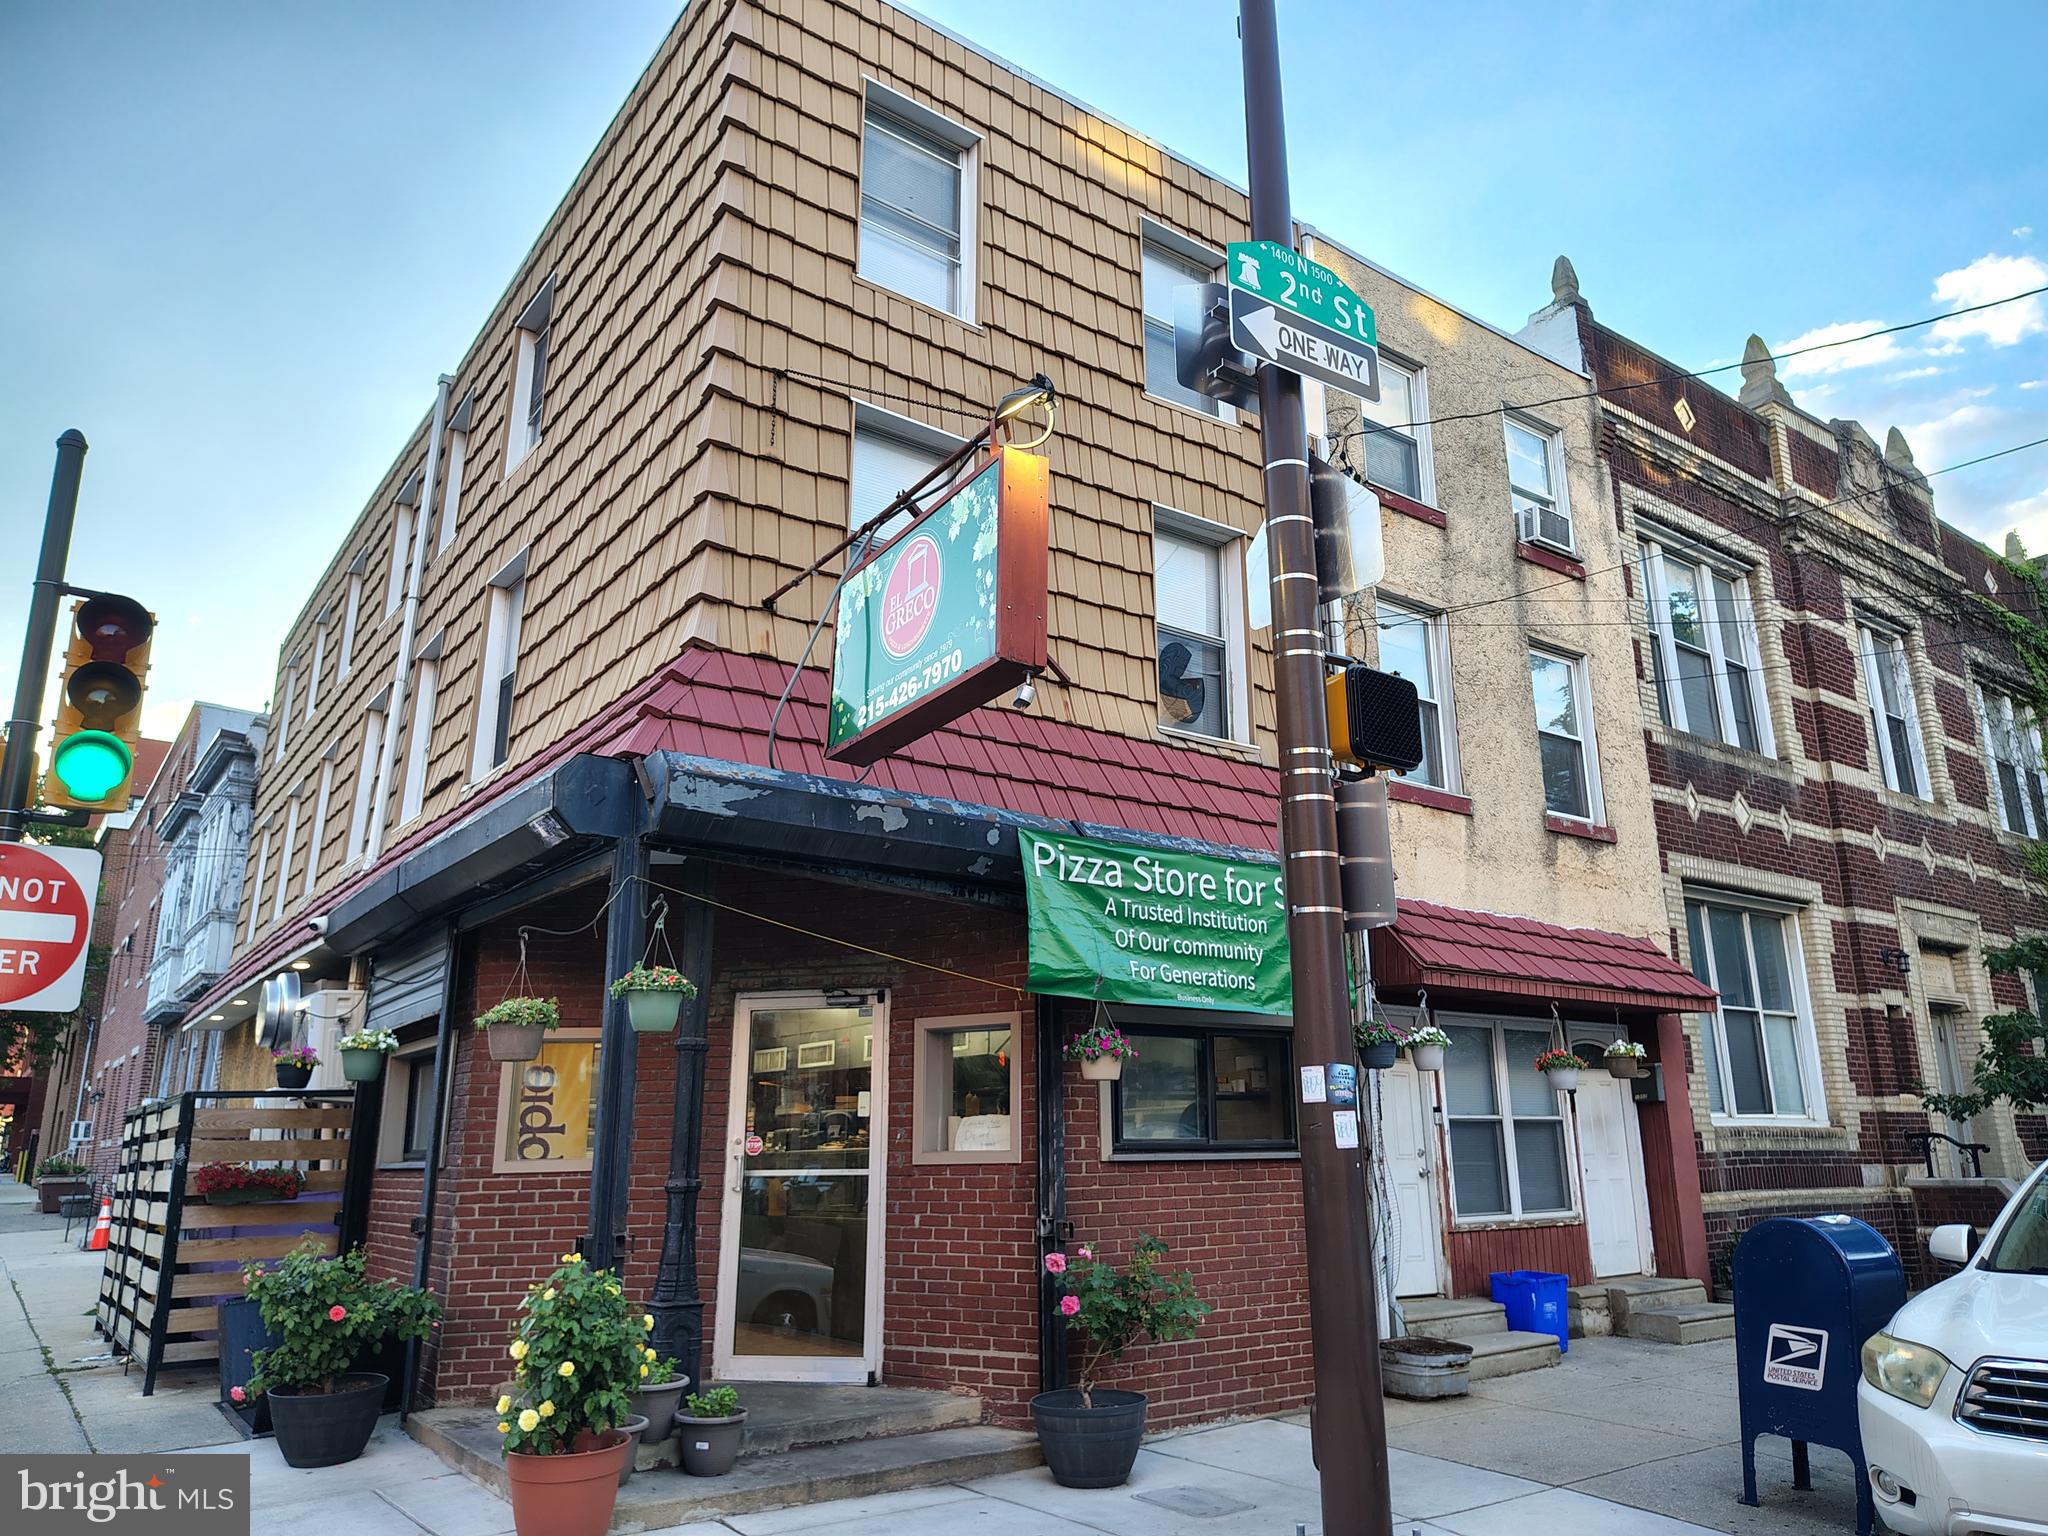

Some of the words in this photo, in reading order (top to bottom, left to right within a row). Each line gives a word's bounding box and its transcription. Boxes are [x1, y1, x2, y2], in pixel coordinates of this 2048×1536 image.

[1271, 246, 1295, 266] 1400
[1297, 258, 1308, 276] N
[1311, 266, 1333, 285] 1500
[1279, 271, 1322, 308] 2nd
[1333, 296, 1368, 338] St
[1278, 326, 1318, 362] ONE
[1326, 344, 1363, 379] WAY
[885, 586, 935, 635] GRECO
[890, 591, 903, 612] EL
[939, 640, 953, 655] 1979
[857, 648, 962, 727] 215-426-7970
[0, 876, 66, 904] NOT
[1033, 841, 1123, 888] Pizza
[1133, 856, 1217, 900] Store
[1224, 867, 1266, 907] for
[1104, 897, 1117, 917] A
[1121, 898, 1183, 924] Trusted
[1188, 906, 1268, 934] Institution
[1115, 928, 1136, 949] Of
[1138, 931, 1170, 953] Our
[1173, 938, 1264, 966] community
[1129, 960, 1157, 981] For
[1159, 964, 1256, 991] Generations
[1177, 993, 1201, 1003] Business
[1202, 995, 1215, 1006] Only
[1767, 1373, 1790, 1382] POSTAL
[1791, 1377, 1819, 1386] SERVICE
[1768, 1365, 1792, 1376] UNITED
[1792, 1370, 1816, 1380] STATES
